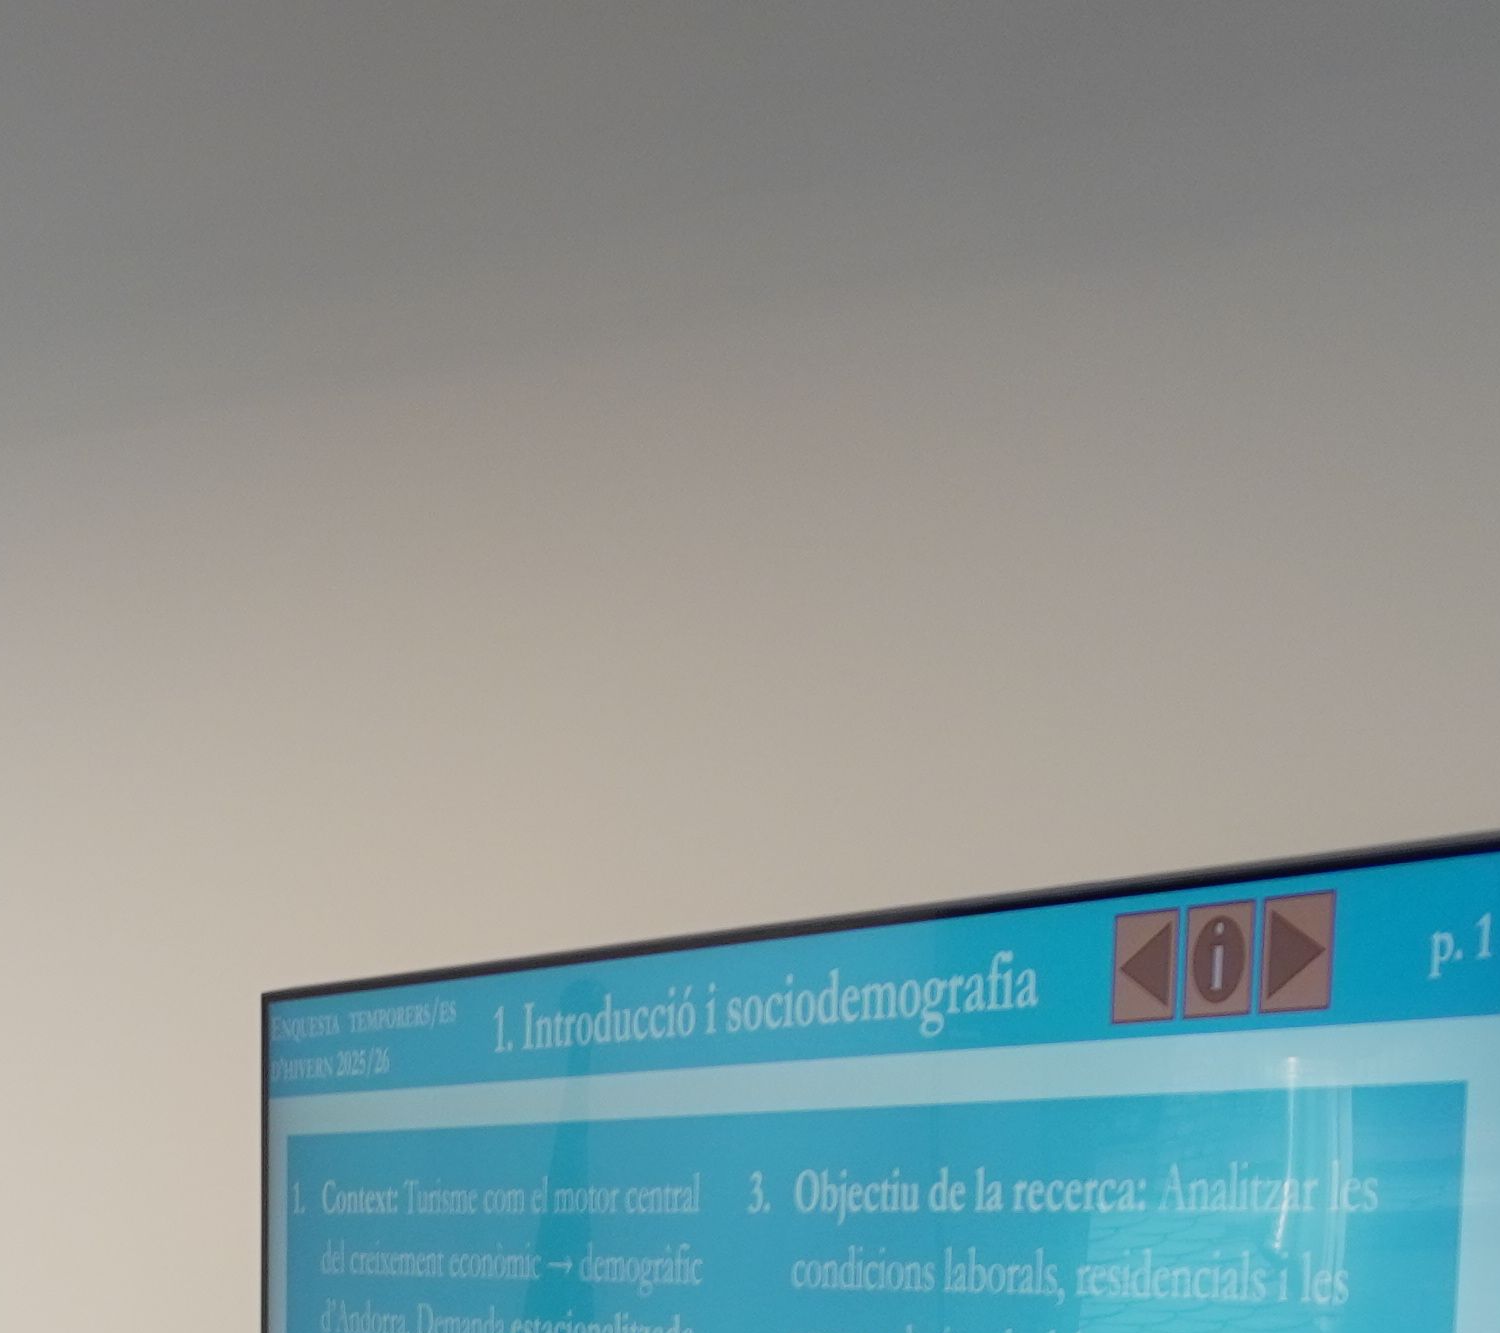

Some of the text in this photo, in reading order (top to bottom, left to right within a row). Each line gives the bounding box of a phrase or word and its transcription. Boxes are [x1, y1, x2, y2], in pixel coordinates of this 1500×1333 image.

[1427, 912, 1493, 979] p. 1
[494, 950, 1039, 1051] 1. Introducció i sociodemografia
[336, 1047, 391, 1078] 2025/26
[322, 1179, 399, 1216] Context:
[403, 1177, 479, 1216] Turisme
[483, 1190, 526, 1214] com
[530, 1175, 549, 1214] el
[554, 1185, 620, 1215] motor
[624, 1172, 701, 1214] central
[746, 1159, 1379, 1227] 3. Objectiu de la recerca: Analitzar les
[320, 1239, 704, 1297] del creixement econòmic demogràfic
[791, 1243, 1350, 1307] condicions laborals, residencials i les
